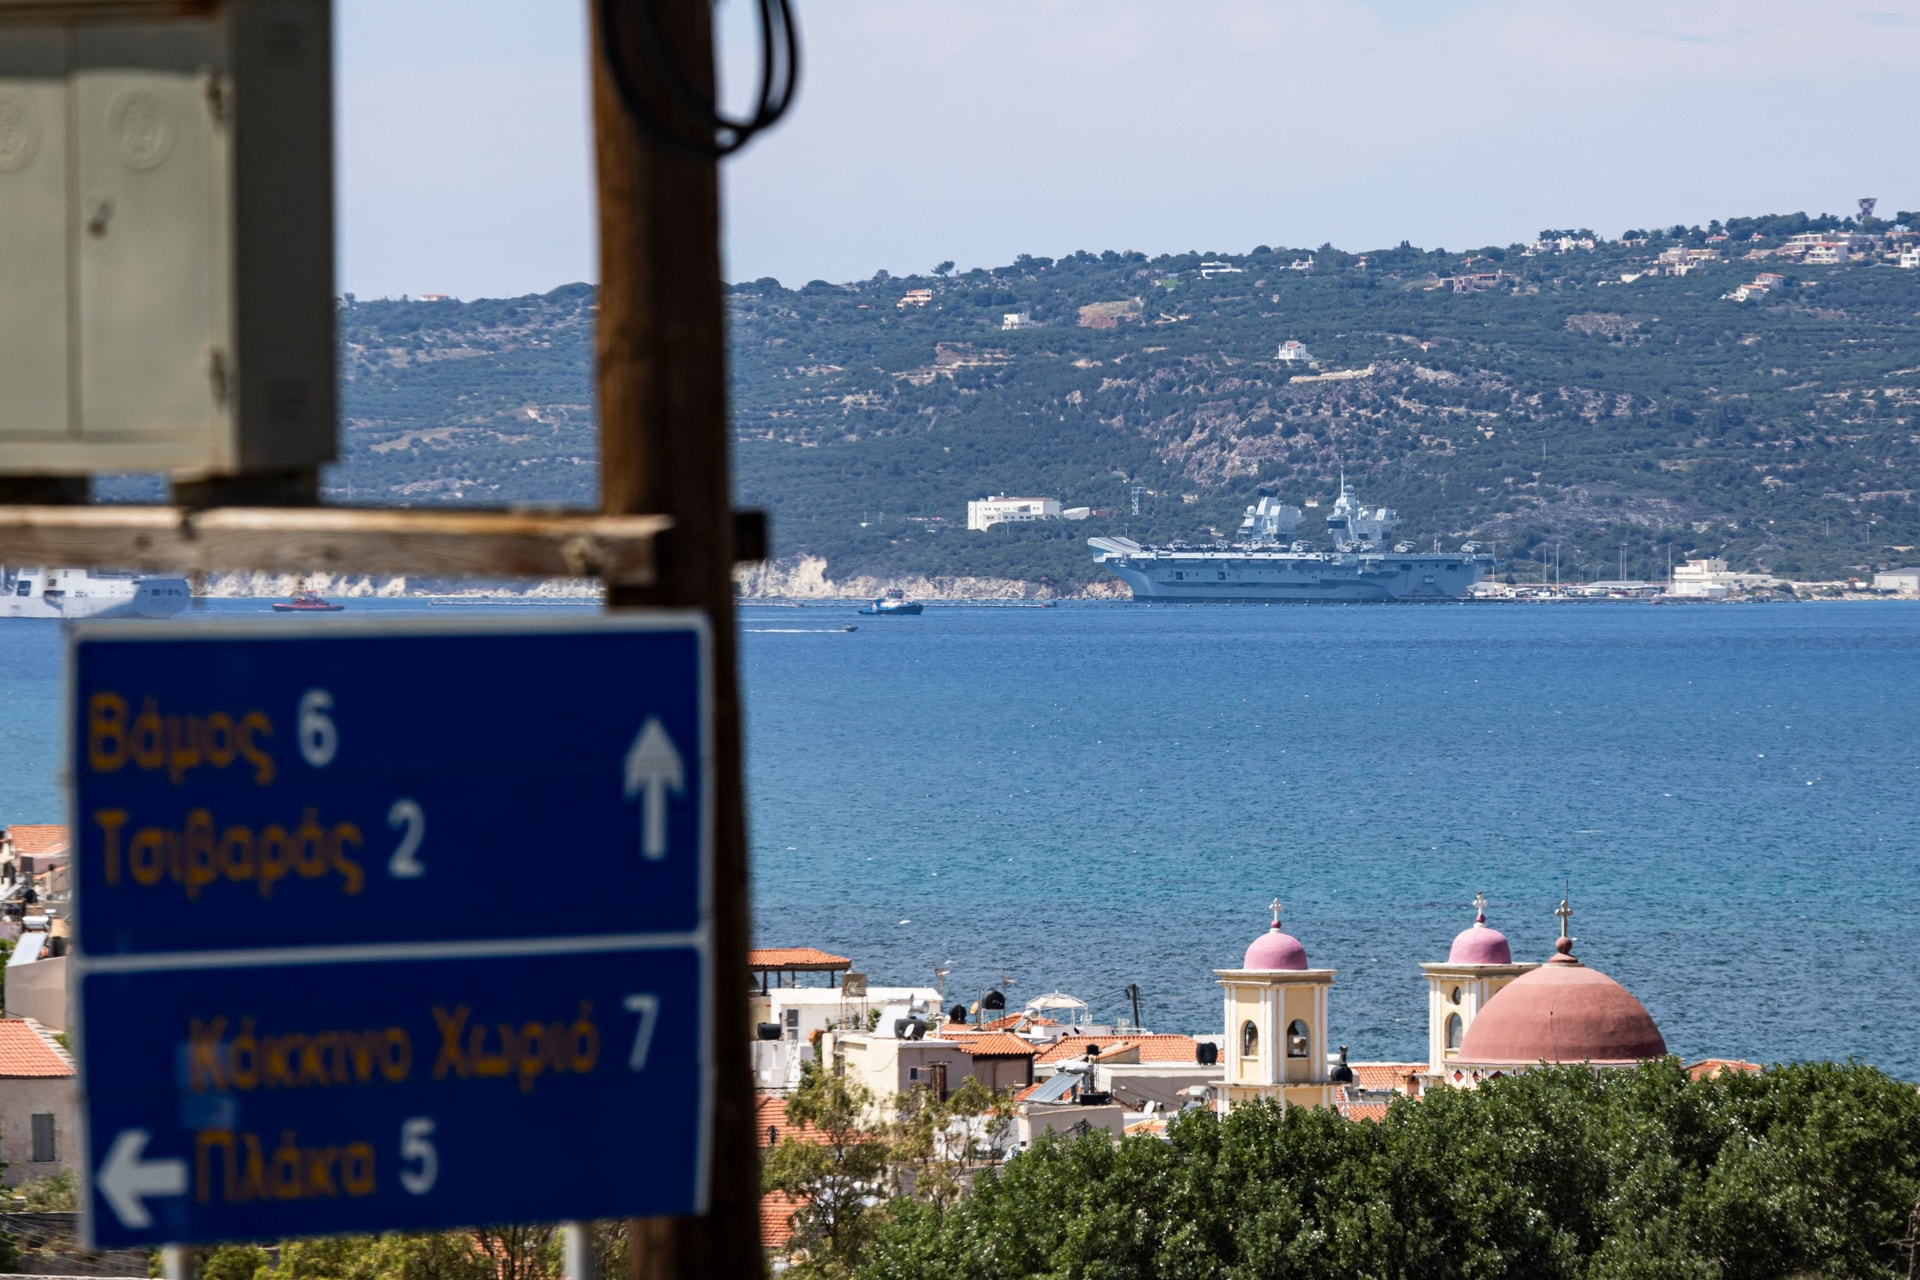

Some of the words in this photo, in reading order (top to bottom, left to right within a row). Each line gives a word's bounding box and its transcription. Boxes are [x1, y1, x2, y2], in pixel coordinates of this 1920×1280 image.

[90, 693, 275, 784] Βάμος
[299, 690, 337, 766] 6
[94, 808, 364, 897] Τσιβαράς
[389, 800, 425, 878] 2
[188, 1016, 412, 1092] Κόκκινο
[432, 1001, 598, 1092] Χωριό
[624, 994, 659, 1069] 7
[196, 1129, 376, 1200] Πλάκα
[401, 1117, 438, 1194] 5
